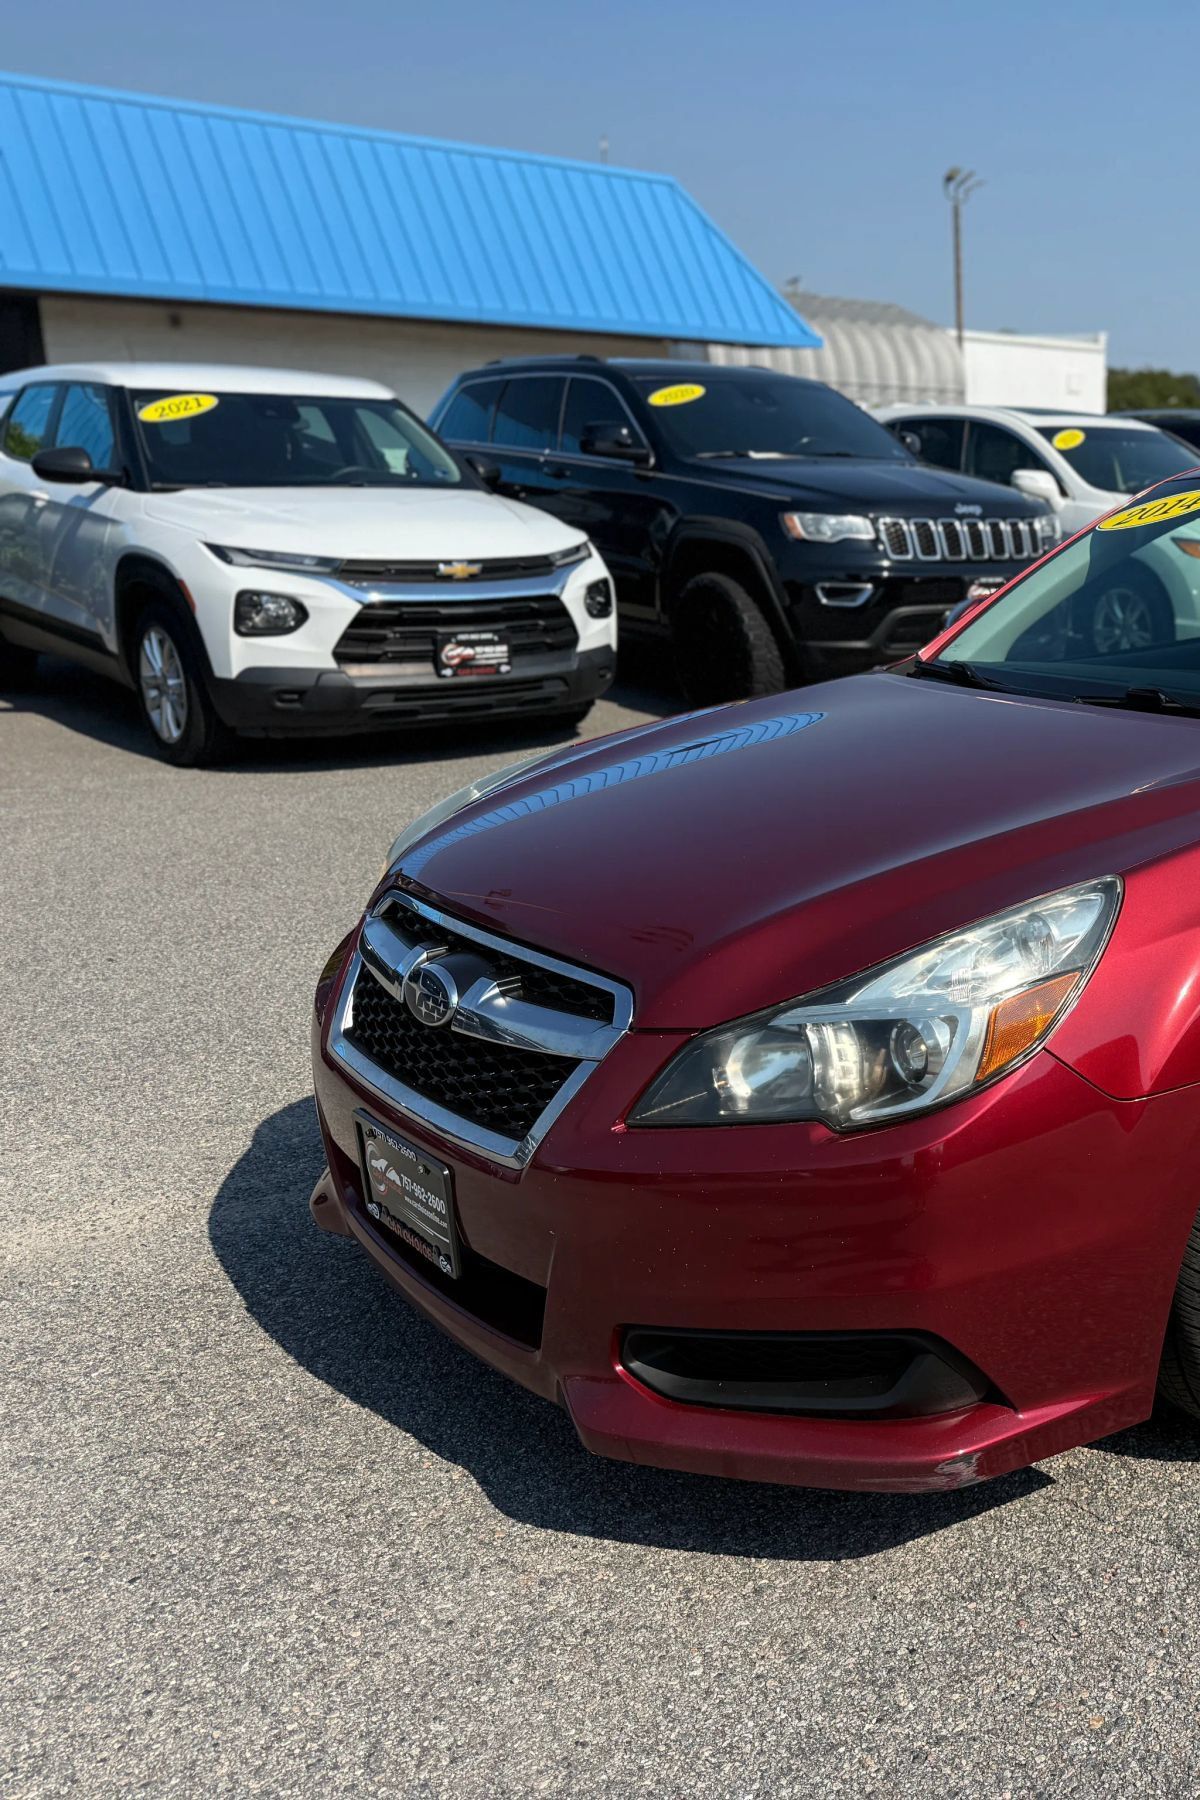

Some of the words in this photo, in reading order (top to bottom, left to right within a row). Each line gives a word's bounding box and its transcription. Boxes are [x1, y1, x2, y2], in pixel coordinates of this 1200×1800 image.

[154, 397, 203, 418] 2021
[954, 502, 983, 516] Jeep
[400, 1173, 446, 1215] 757-962-2600
